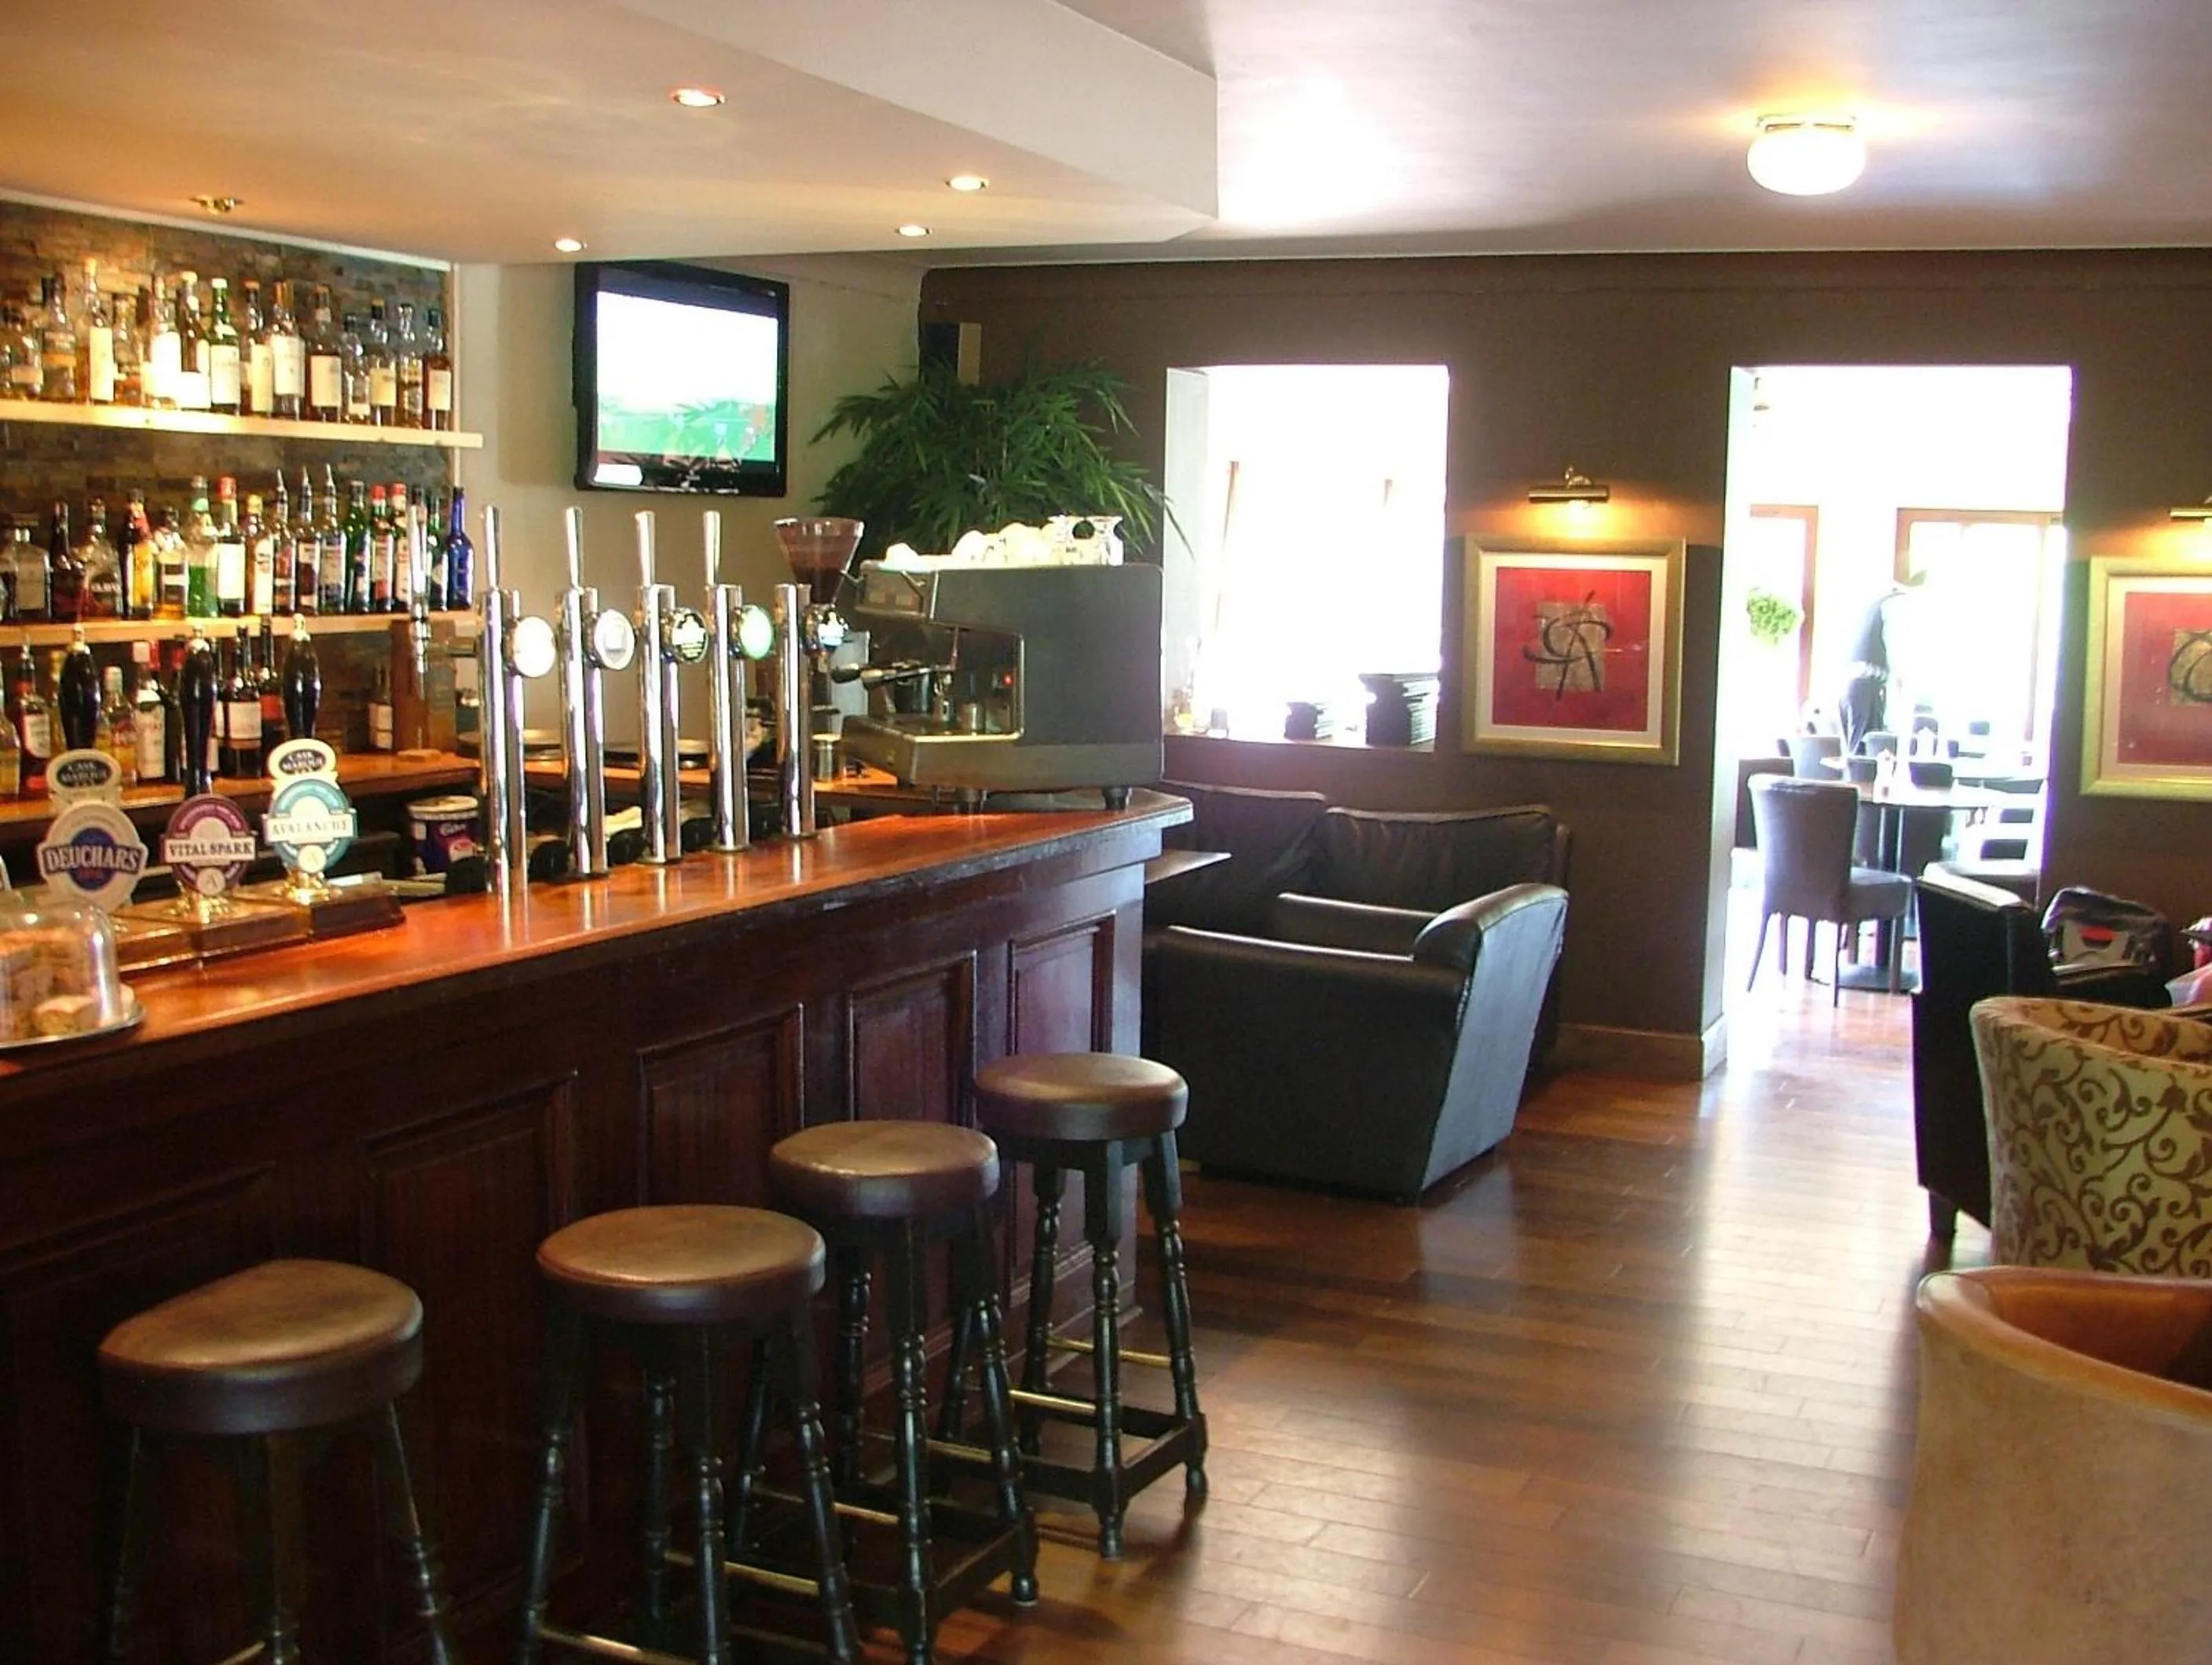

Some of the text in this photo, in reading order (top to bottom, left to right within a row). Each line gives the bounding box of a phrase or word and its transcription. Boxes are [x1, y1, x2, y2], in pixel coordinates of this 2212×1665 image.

[45, 845, 140, 871] DEUCHARS
[169, 841, 253, 857] VITAL SPARK
